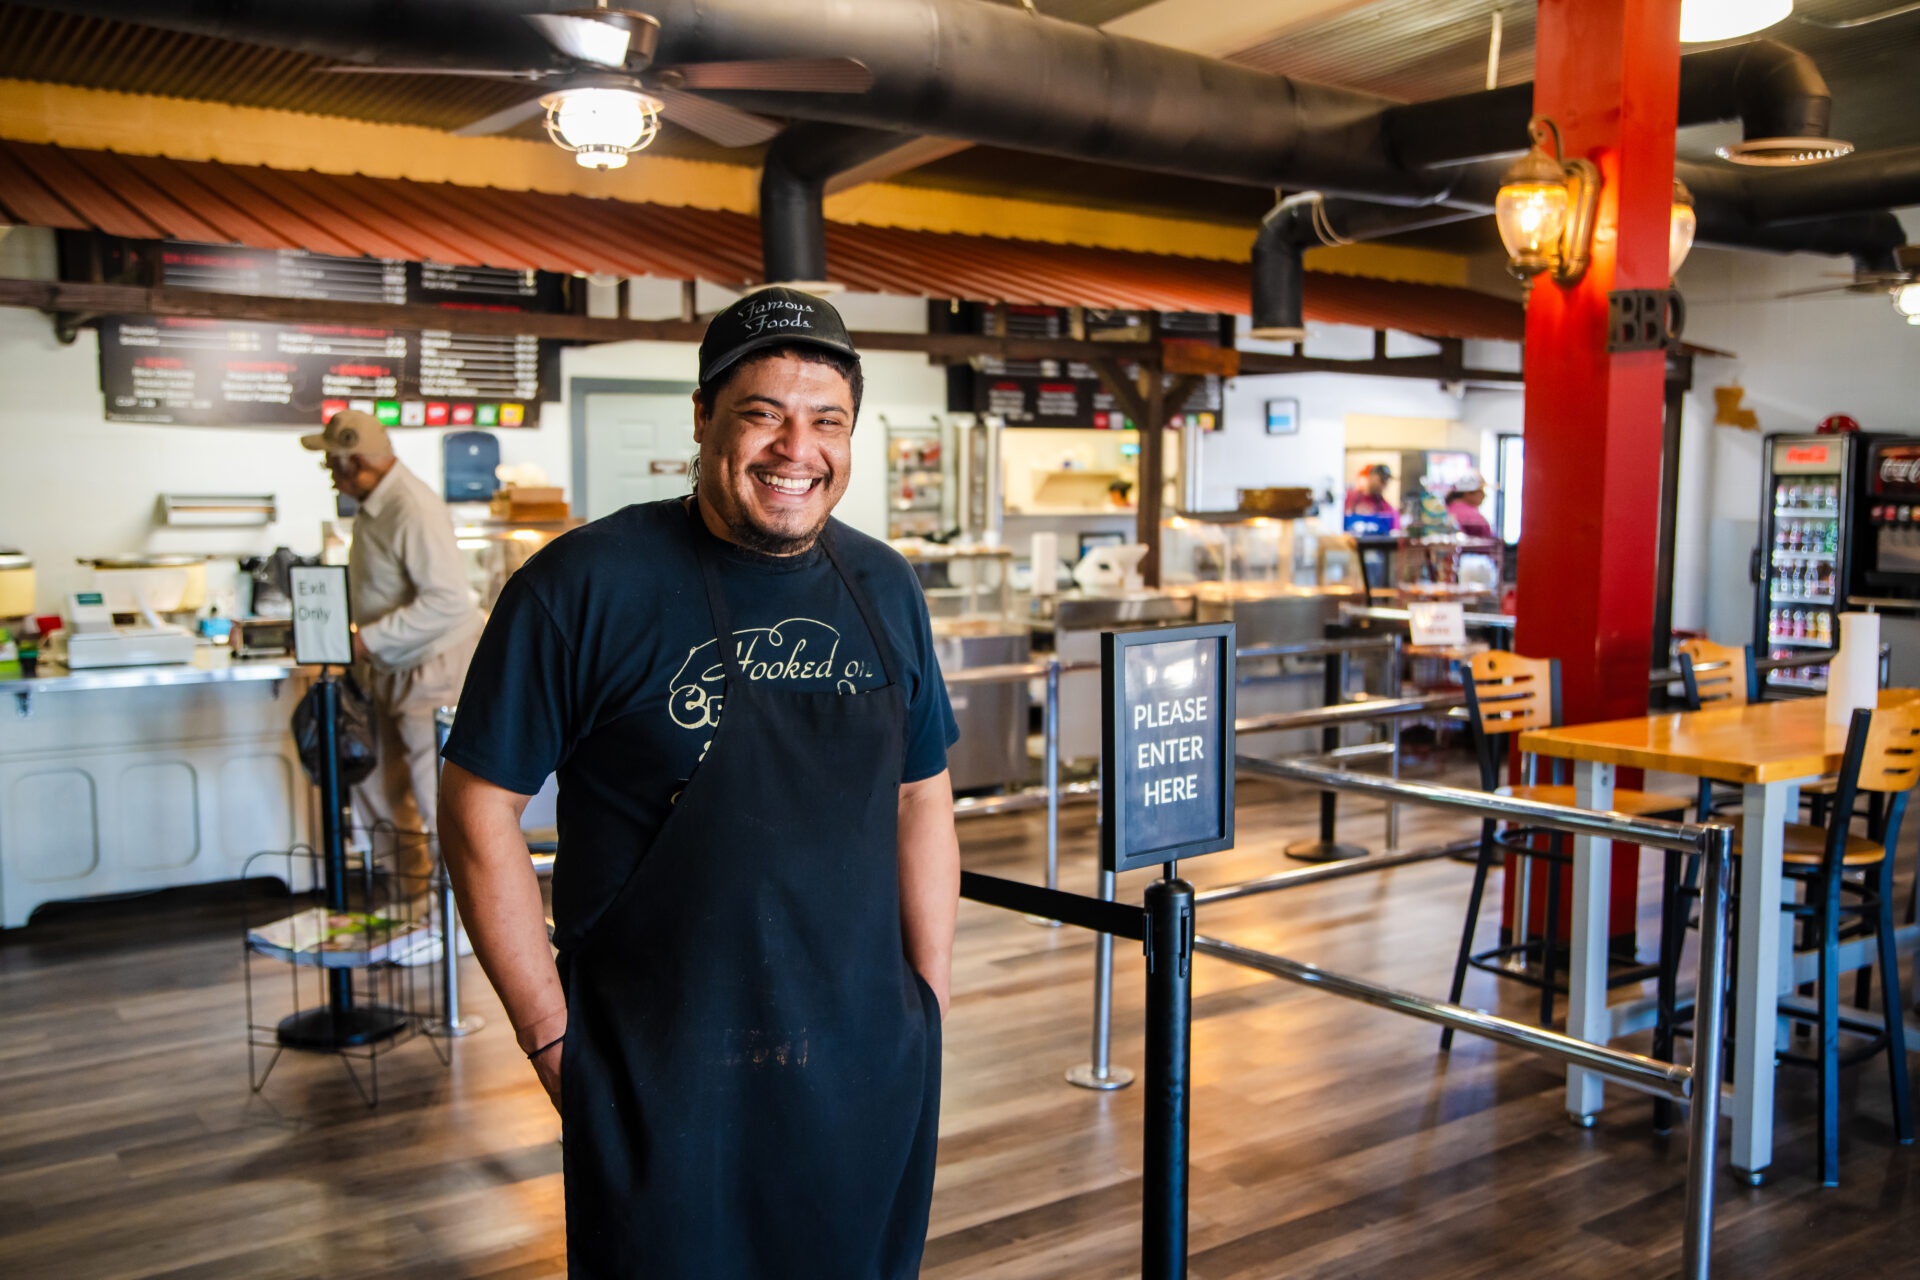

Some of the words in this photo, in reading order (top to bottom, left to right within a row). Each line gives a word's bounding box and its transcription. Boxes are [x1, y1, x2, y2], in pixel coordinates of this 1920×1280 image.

[738, 299, 815, 320] Famous
[743, 312, 813, 339] Foods
[298, 581, 327, 596] Exit
[298, 606, 332, 623] Only
[1134, 696, 1208, 730] PLEASE
[1138, 735, 1204, 769] ENTER
[1144, 774, 1198, 807] HERE
